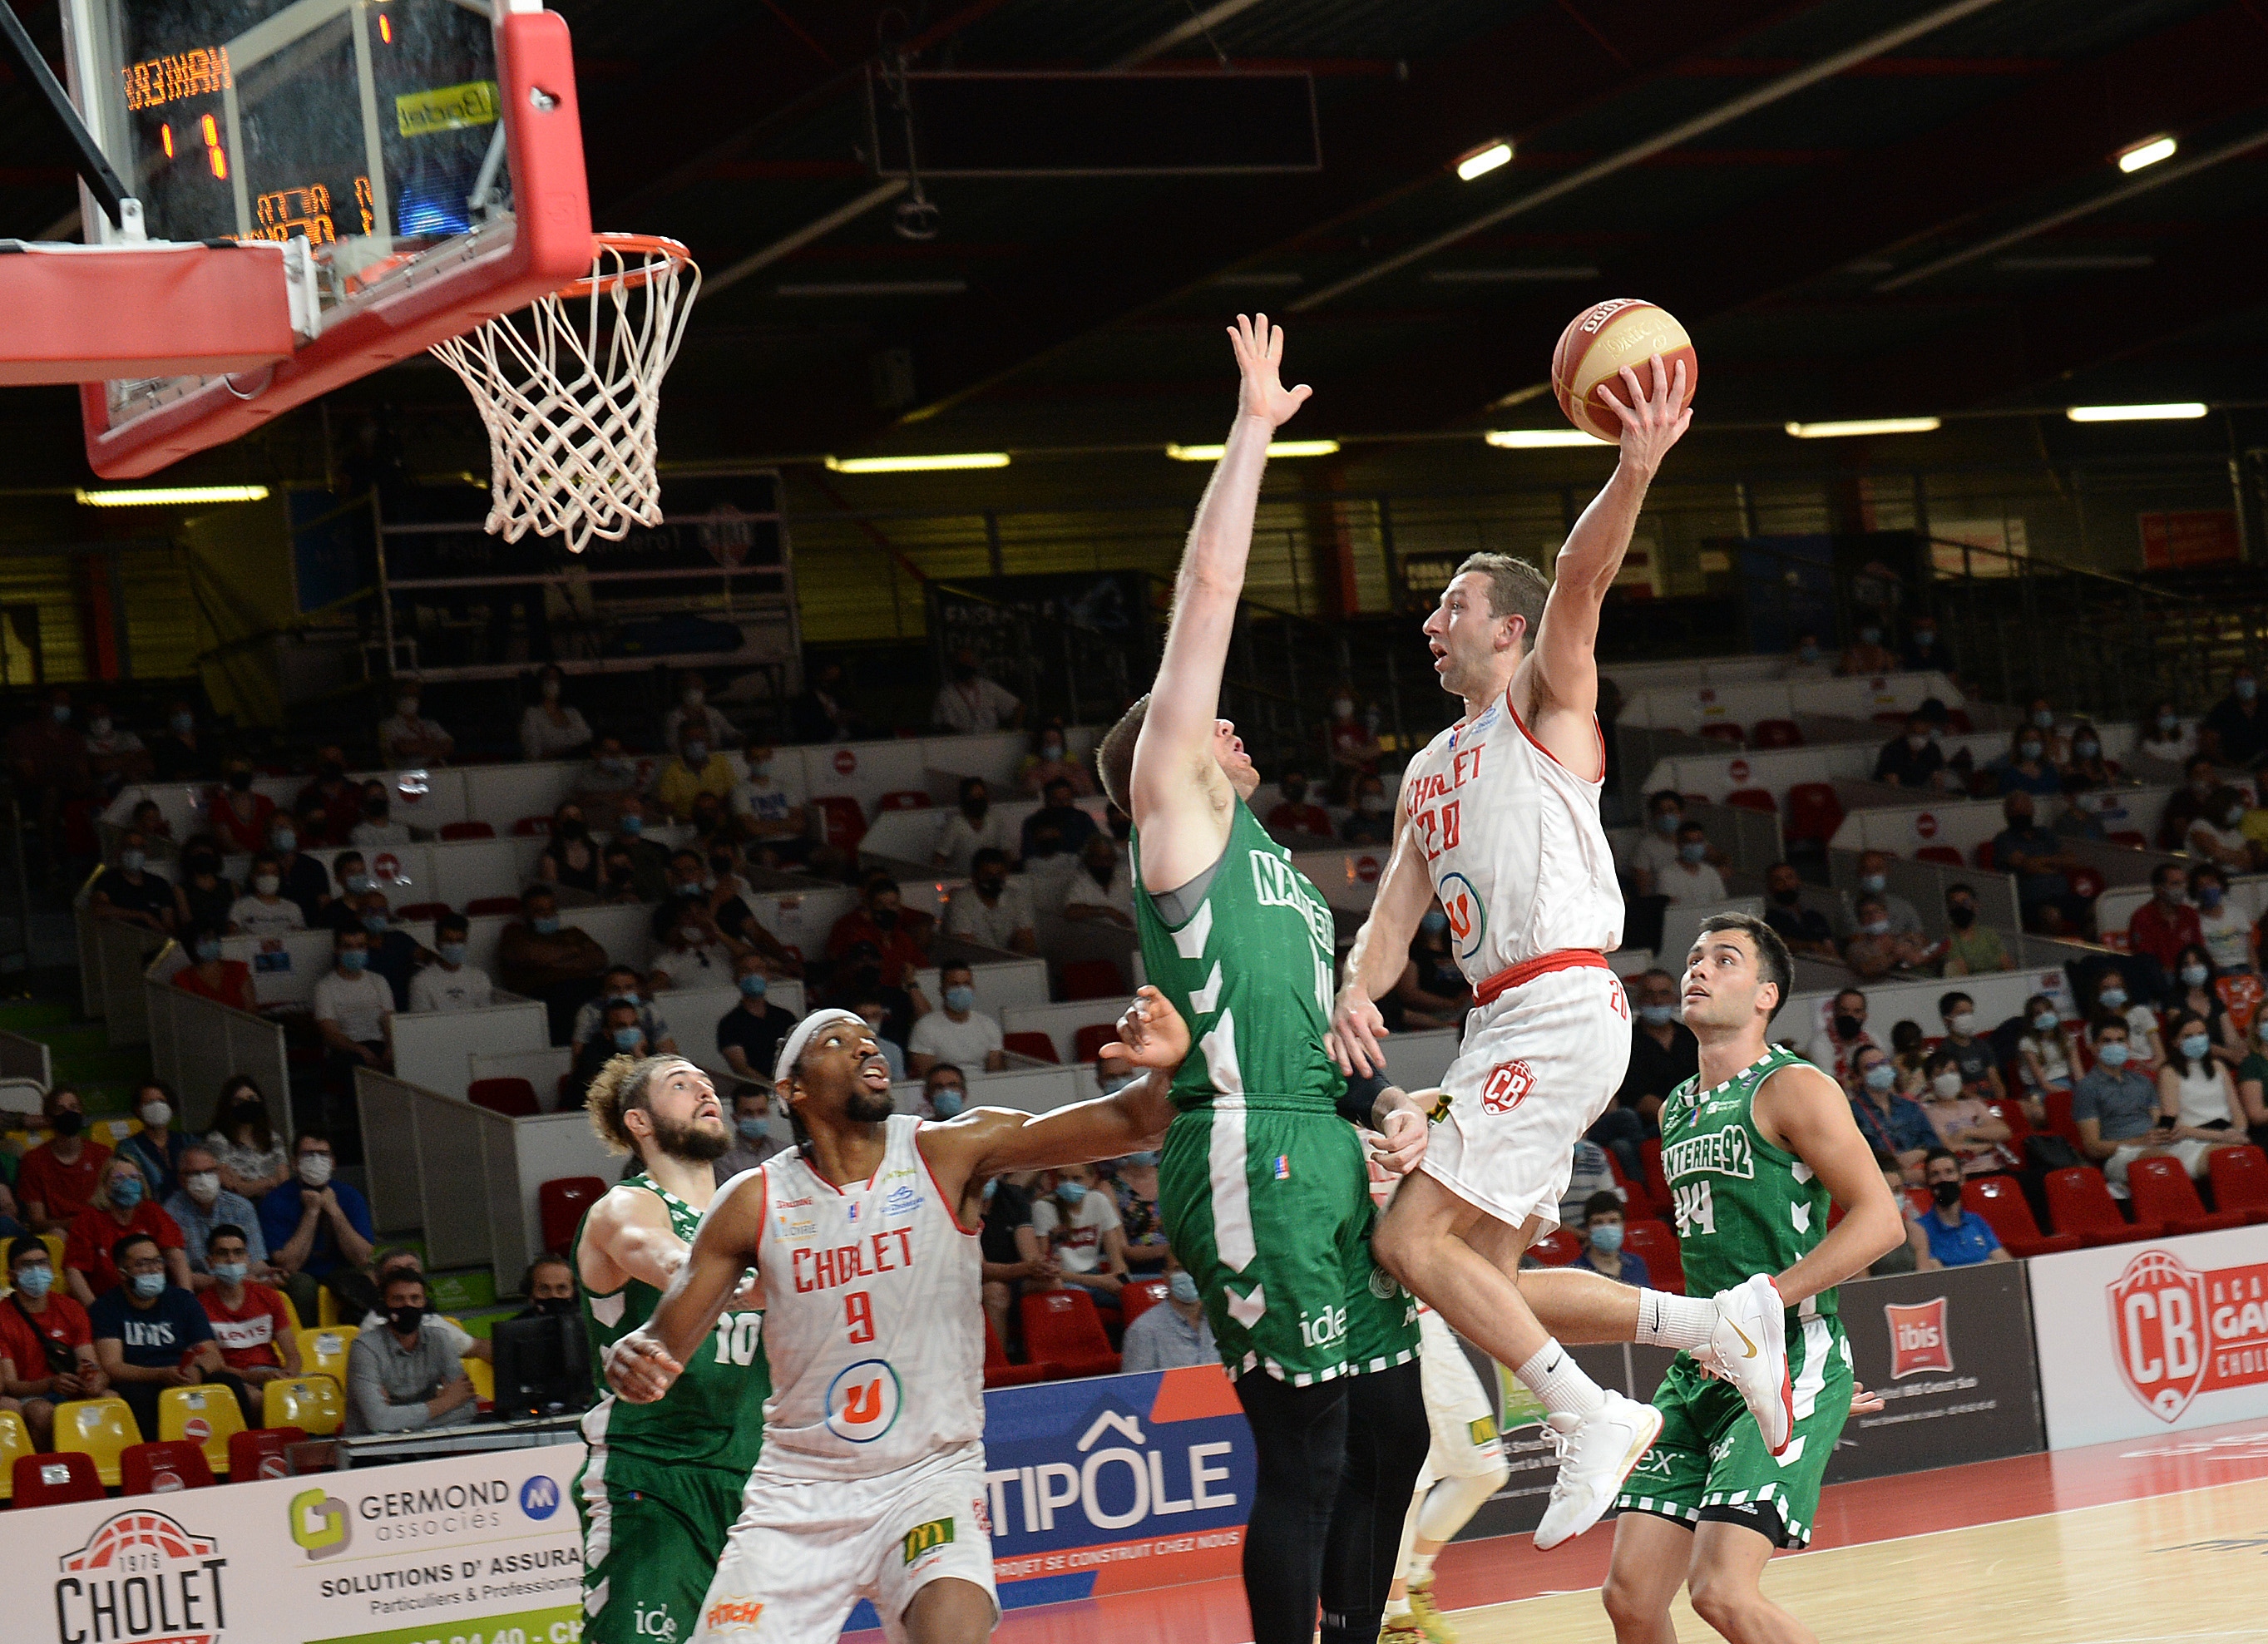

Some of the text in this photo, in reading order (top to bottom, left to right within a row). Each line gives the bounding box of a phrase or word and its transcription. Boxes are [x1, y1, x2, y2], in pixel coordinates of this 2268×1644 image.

[1416, 798, 1460, 861] 20
[1484, 1069, 1527, 1106] CB
[1661, 1124, 1755, 1180] NTERRE92
[714, 1311, 762, 1365] 10
[843, 1291, 876, 1345] 9
[1898, 1322, 1940, 1352] ibis
[2124, 1287, 2200, 1385] CB
[2216, 1348, 2268, 1378] CHOL
[986, 1410, 1238, 1537] TIPÔLE
[359, 1479, 509, 1521] GERMOND
[376, 1508, 501, 1543] associés
[321, 1564, 453, 1598] SOLUTIONS
[490, 1547, 581, 1576] ASSURA
[1045, 1555, 1065, 1572] SE
[1068, 1543, 1152, 1567] CONSTRUIT
[1156, 1538, 1194, 1557] CHEZ
[1198, 1531, 1240, 1550] NOUS
[56, 1558, 227, 1644] CHOLET
[371, 1592, 461, 1616] Particuliers
[466, 1587, 479, 1602] &
